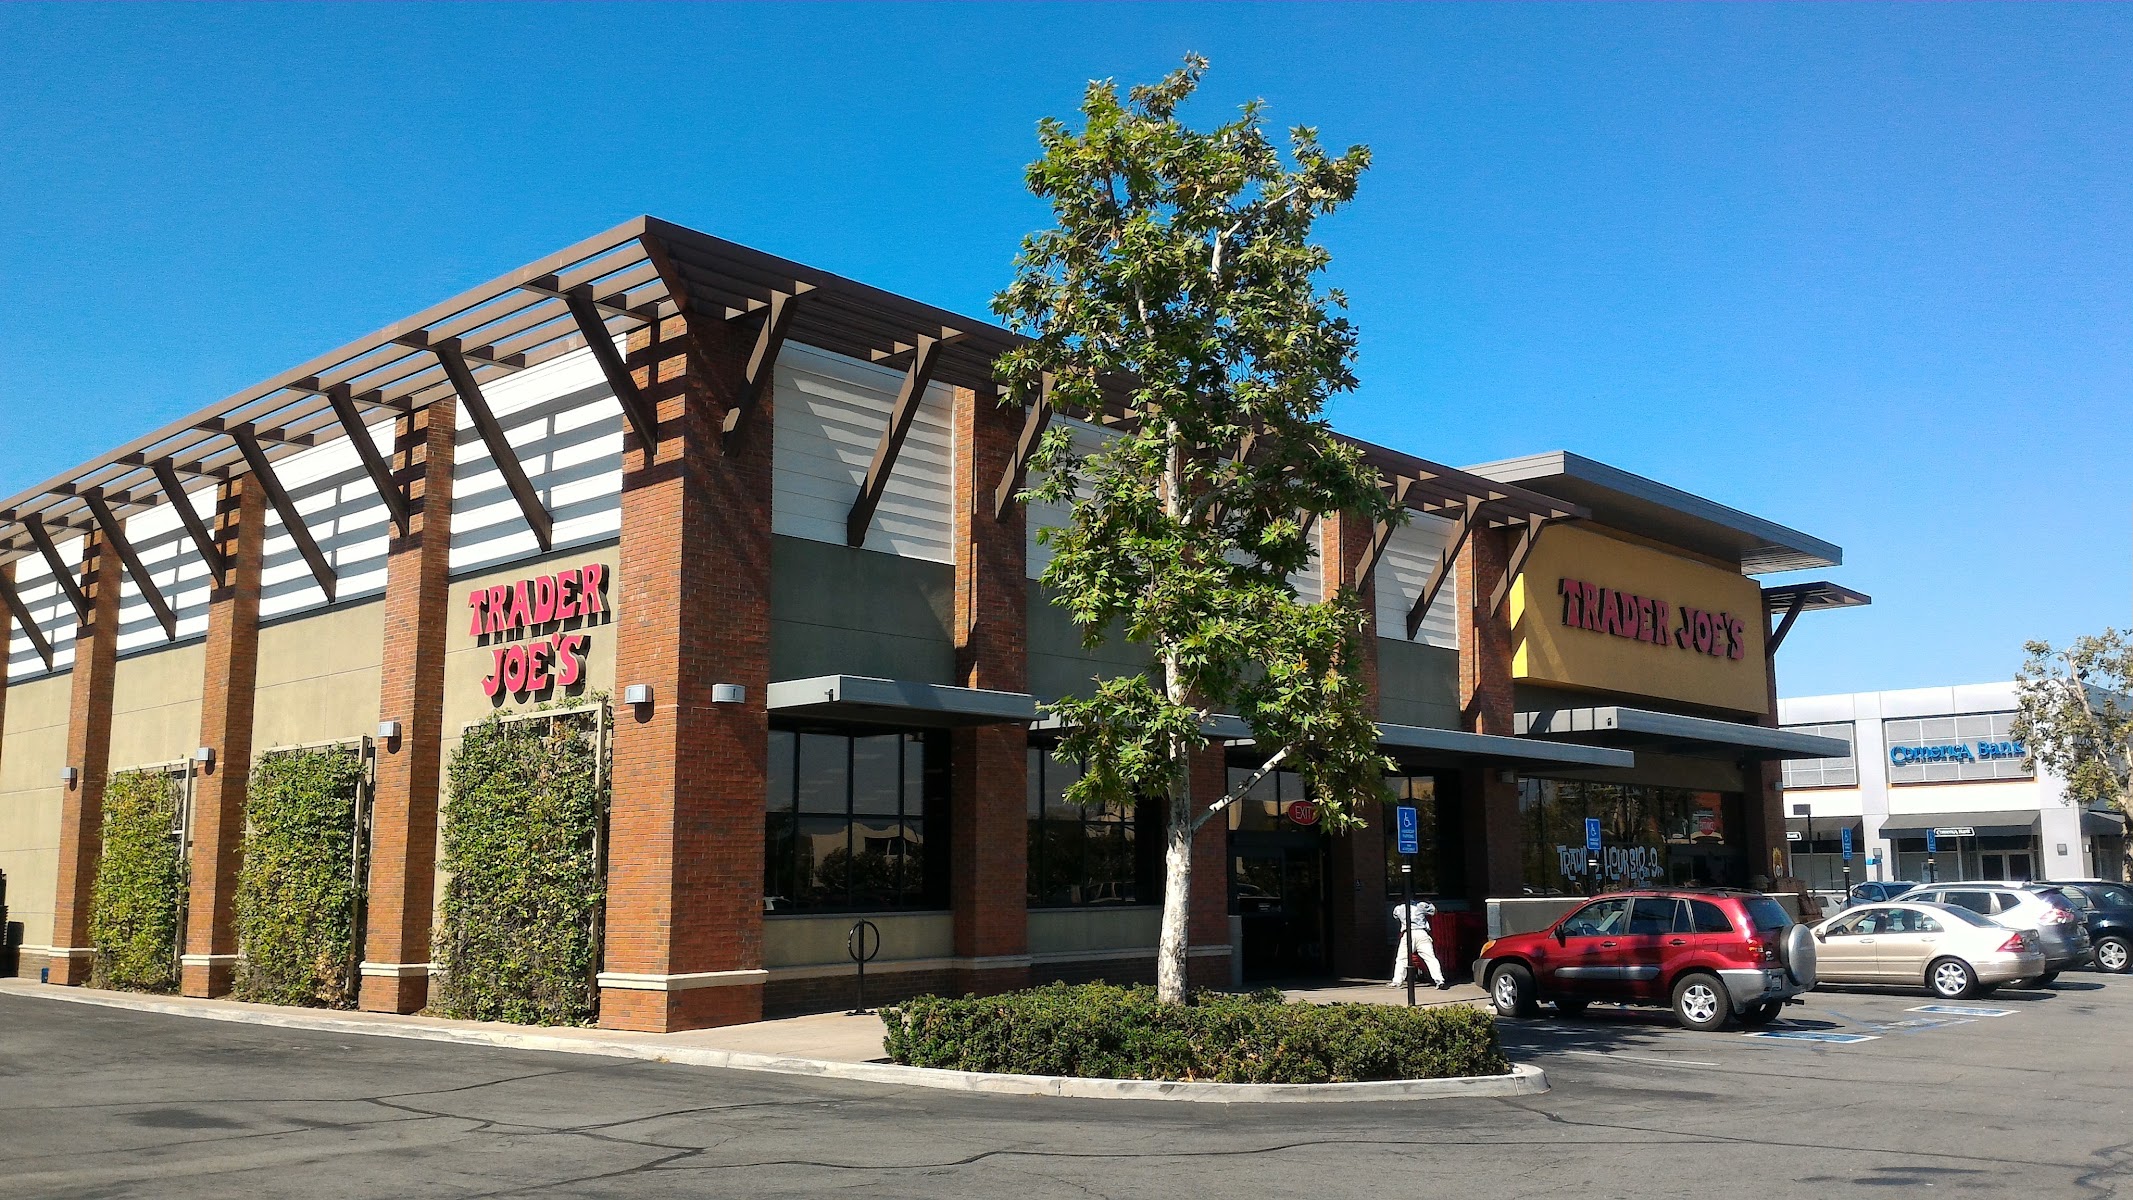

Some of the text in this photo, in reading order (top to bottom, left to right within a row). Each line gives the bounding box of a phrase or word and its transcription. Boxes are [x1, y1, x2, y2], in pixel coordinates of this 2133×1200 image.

[469, 562, 606, 637] TRADER
[1559, 578, 1745, 660] TRADER JOE'S
[481, 632, 586, 699] JOE'S
[1977, 740, 2026, 759] Bank
[1295, 805, 1312, 820] EXIT
